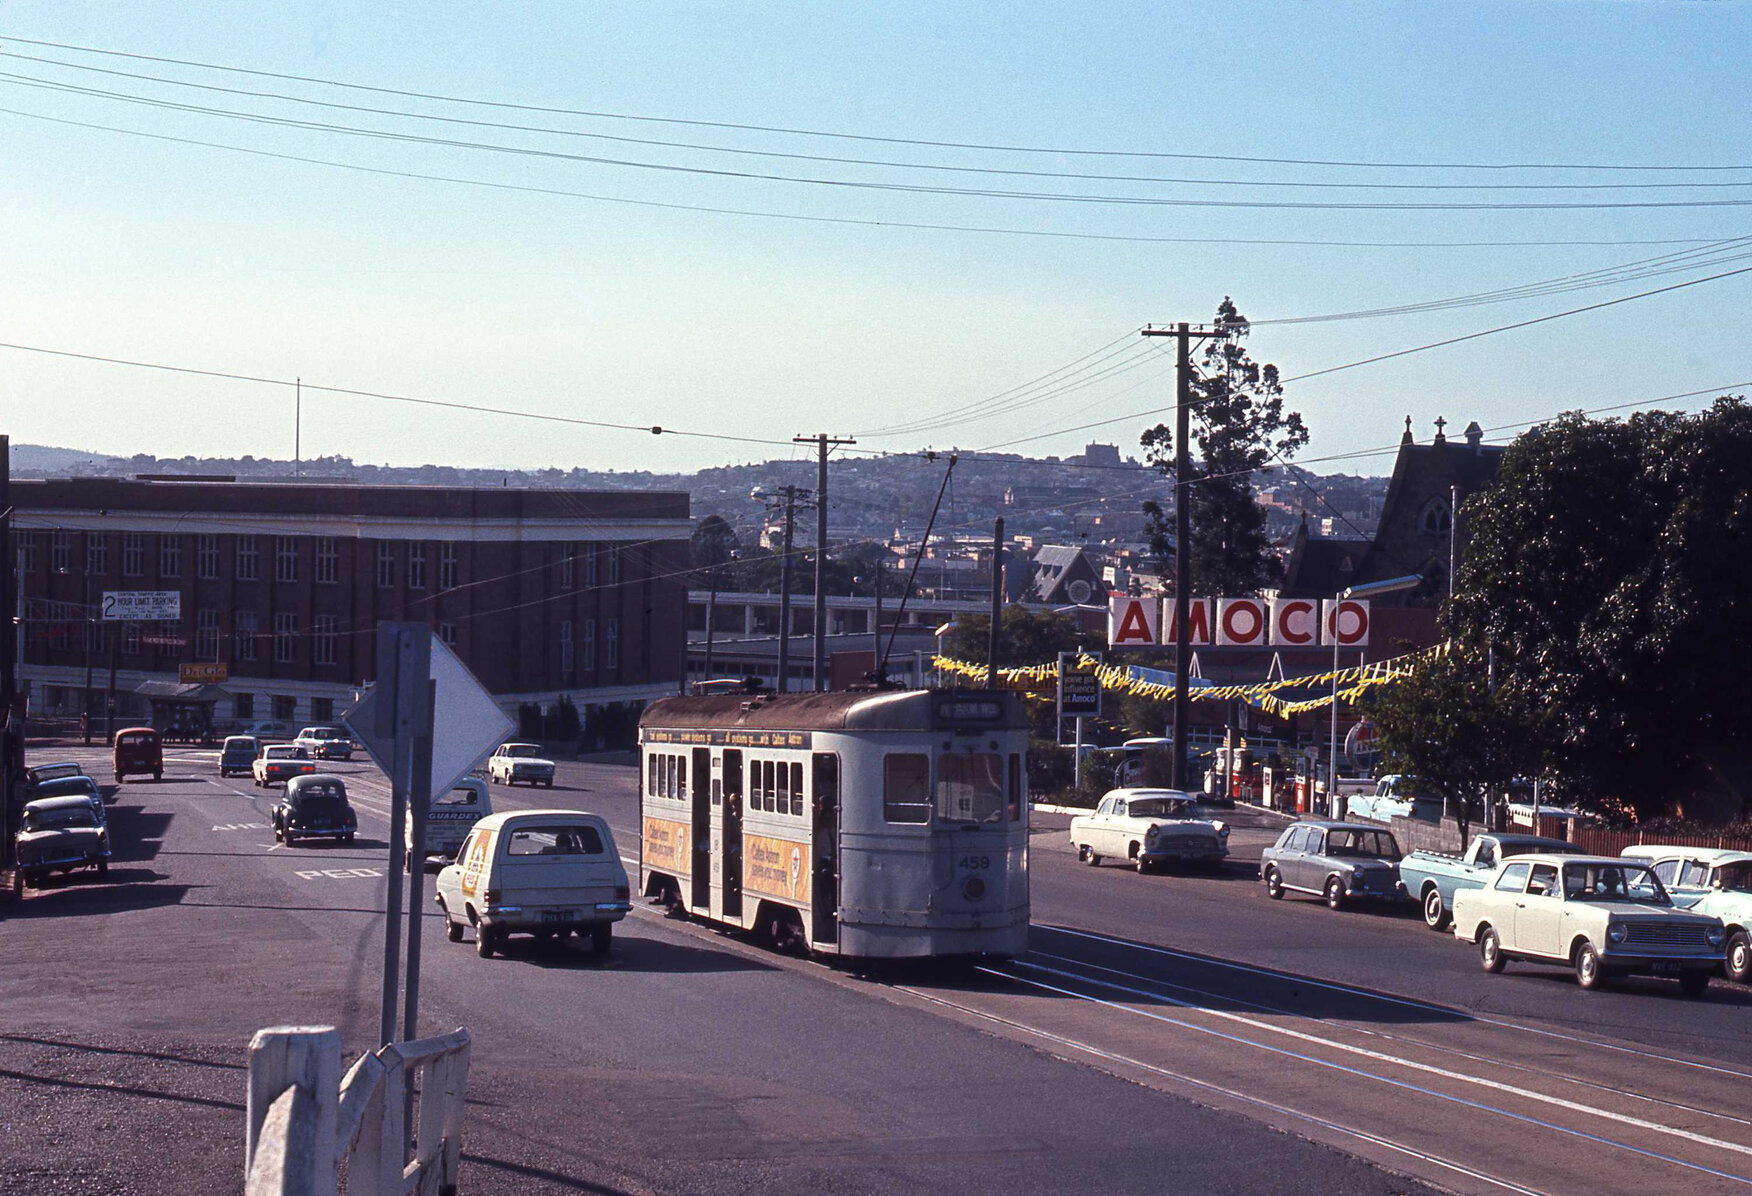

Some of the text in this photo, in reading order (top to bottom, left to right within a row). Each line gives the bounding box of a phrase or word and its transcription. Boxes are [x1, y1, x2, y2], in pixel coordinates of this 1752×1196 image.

[105, 596, 116, 617] 2
[117, 598, 133, 606] HOUR
[152, 597, 177, 605] PARKING
[1115, 600, 1368, 643] AMOCO
[959, 856, 990, 870] 459
